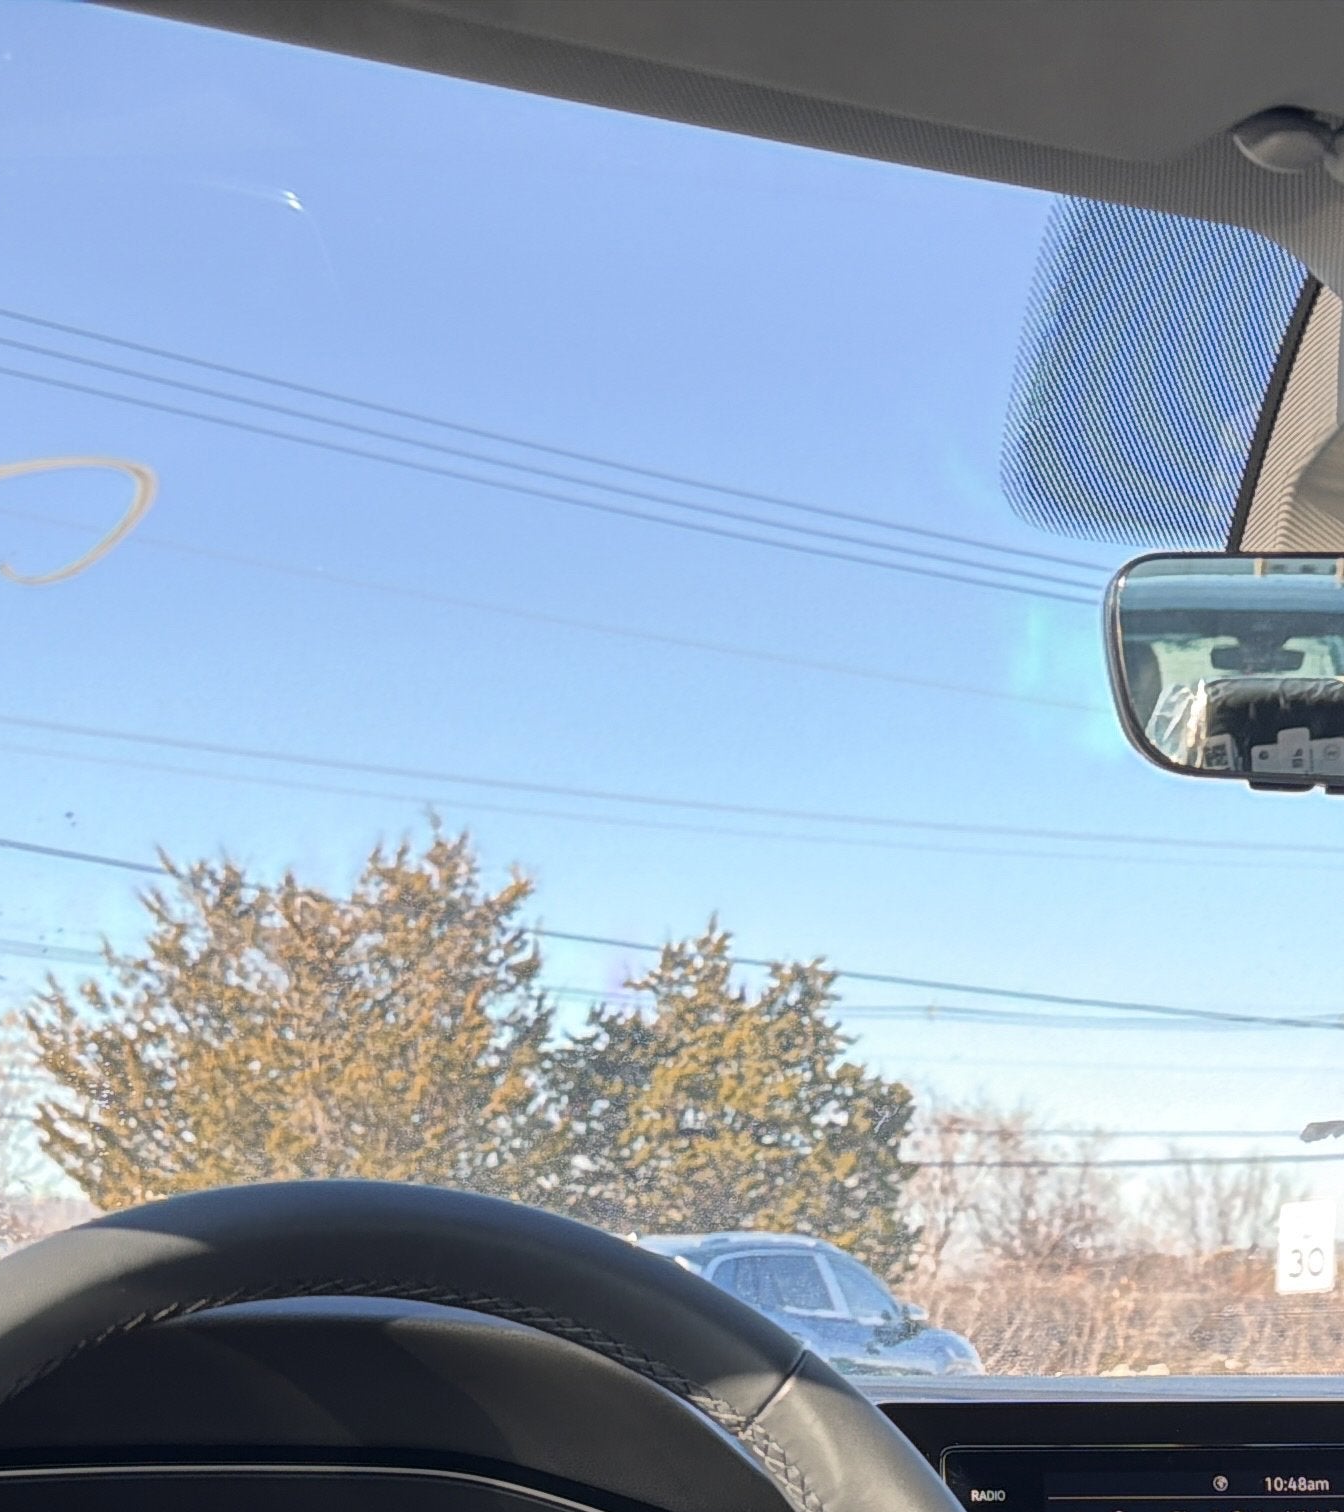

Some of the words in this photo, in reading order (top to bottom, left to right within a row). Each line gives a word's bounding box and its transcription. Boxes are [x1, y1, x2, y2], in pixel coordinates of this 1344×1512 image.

[1288, 1246, 1326, 1279] 30
[1264, 1476, 1330, 1492] 10:48am
[970, 1490, 1006, 1501] RADIO
